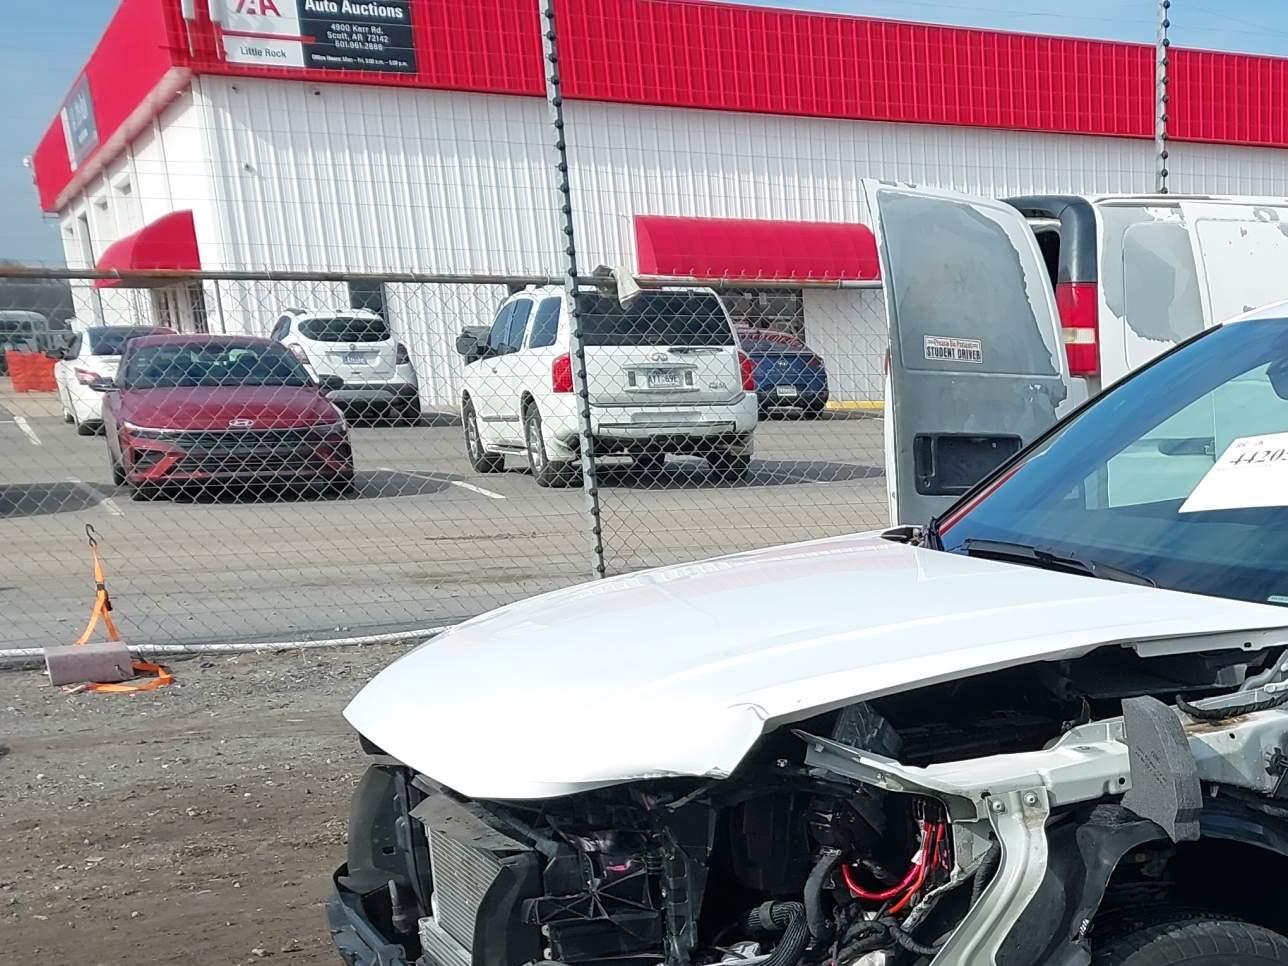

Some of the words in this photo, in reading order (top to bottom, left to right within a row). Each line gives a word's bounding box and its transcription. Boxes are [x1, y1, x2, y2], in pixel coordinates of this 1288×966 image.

[304, 0, 338, 13] Auto
[341, 0, 404, 18] Auctions
[330, 23, 351, 32] 4900
[371, 25, 384, 34] Rd.
[327, 31, 350, 41] Scott,
[351, 33, 364, 42] AR
[366, 34, 389, 43] 72142
[240, 46, 263, 56] Little
[264, 48, 287, 58] Rock
[926, 346, 955, 359] STUDENT
[957, 349, 980, 361] DRIVER
